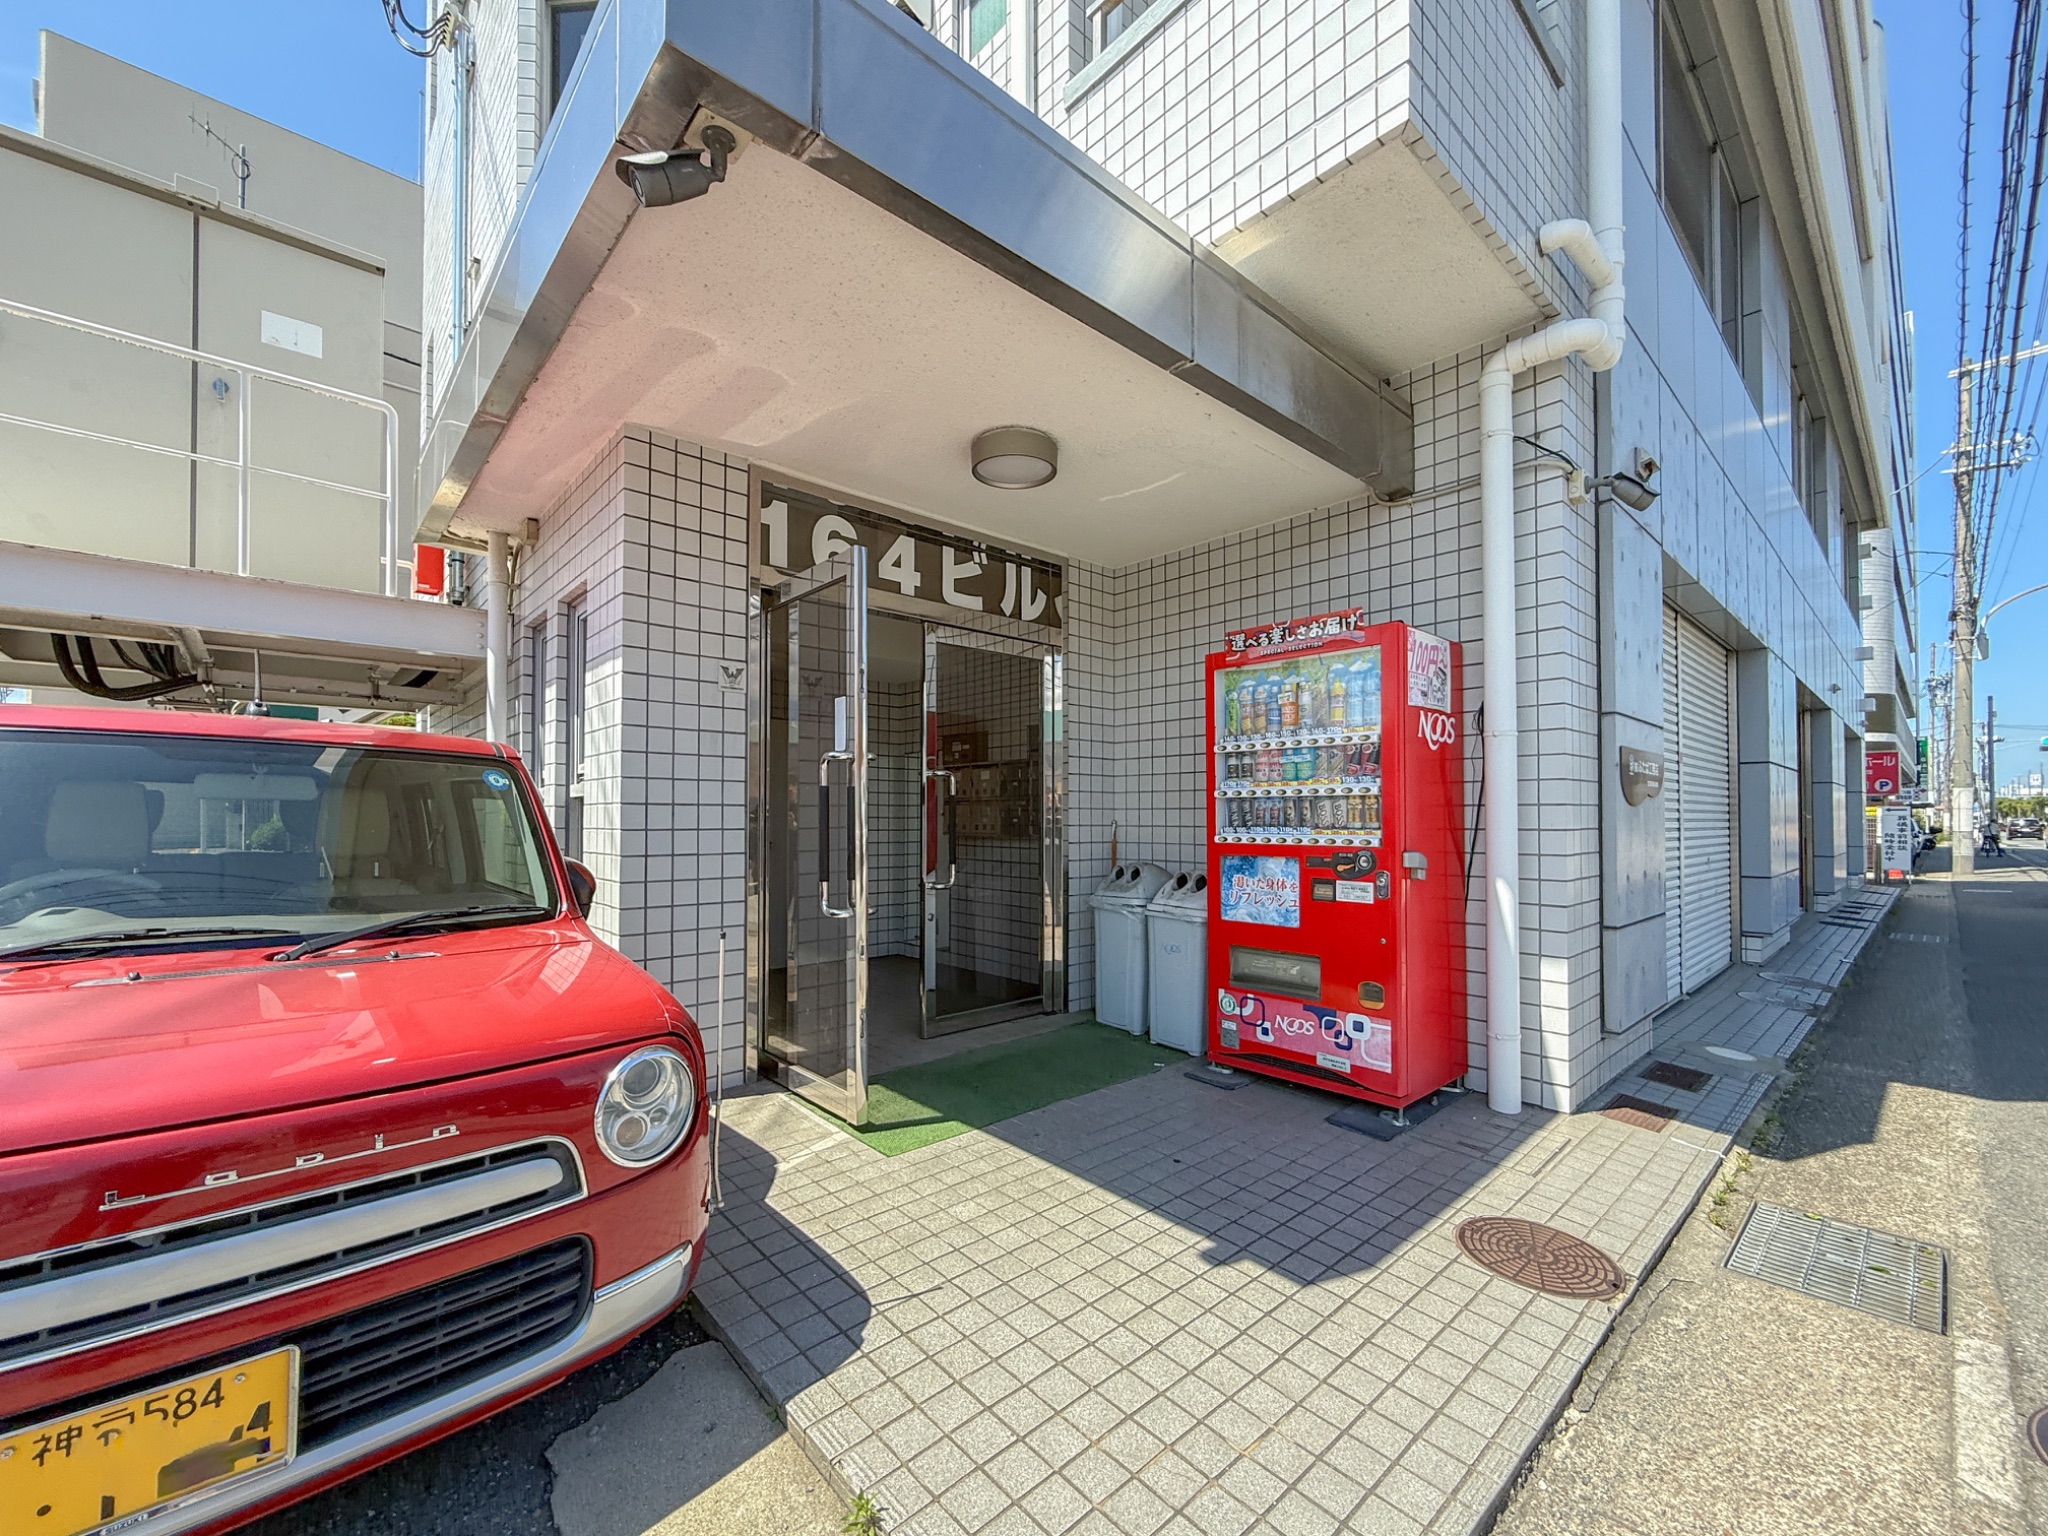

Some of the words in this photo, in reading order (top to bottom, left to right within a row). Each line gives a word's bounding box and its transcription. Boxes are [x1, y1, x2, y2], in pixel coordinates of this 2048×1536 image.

[1231, 614, 1357, 651] 選べる楽しさお届け
[1260, 647, 1284, 656] SPECIAL
[1288, 641, 1323, 652] SELECTION
[1879, 780, 1890, 790] P
[1334, 803, 1346, 826] BOSS
[1229, 890, 1299, 908] リフレッシュ
[1274, 1015, 1315, 1036] NOOS
[144, 1377, 225, 1421] 584
[104, 1514, 146, 1536] SUZUKI
